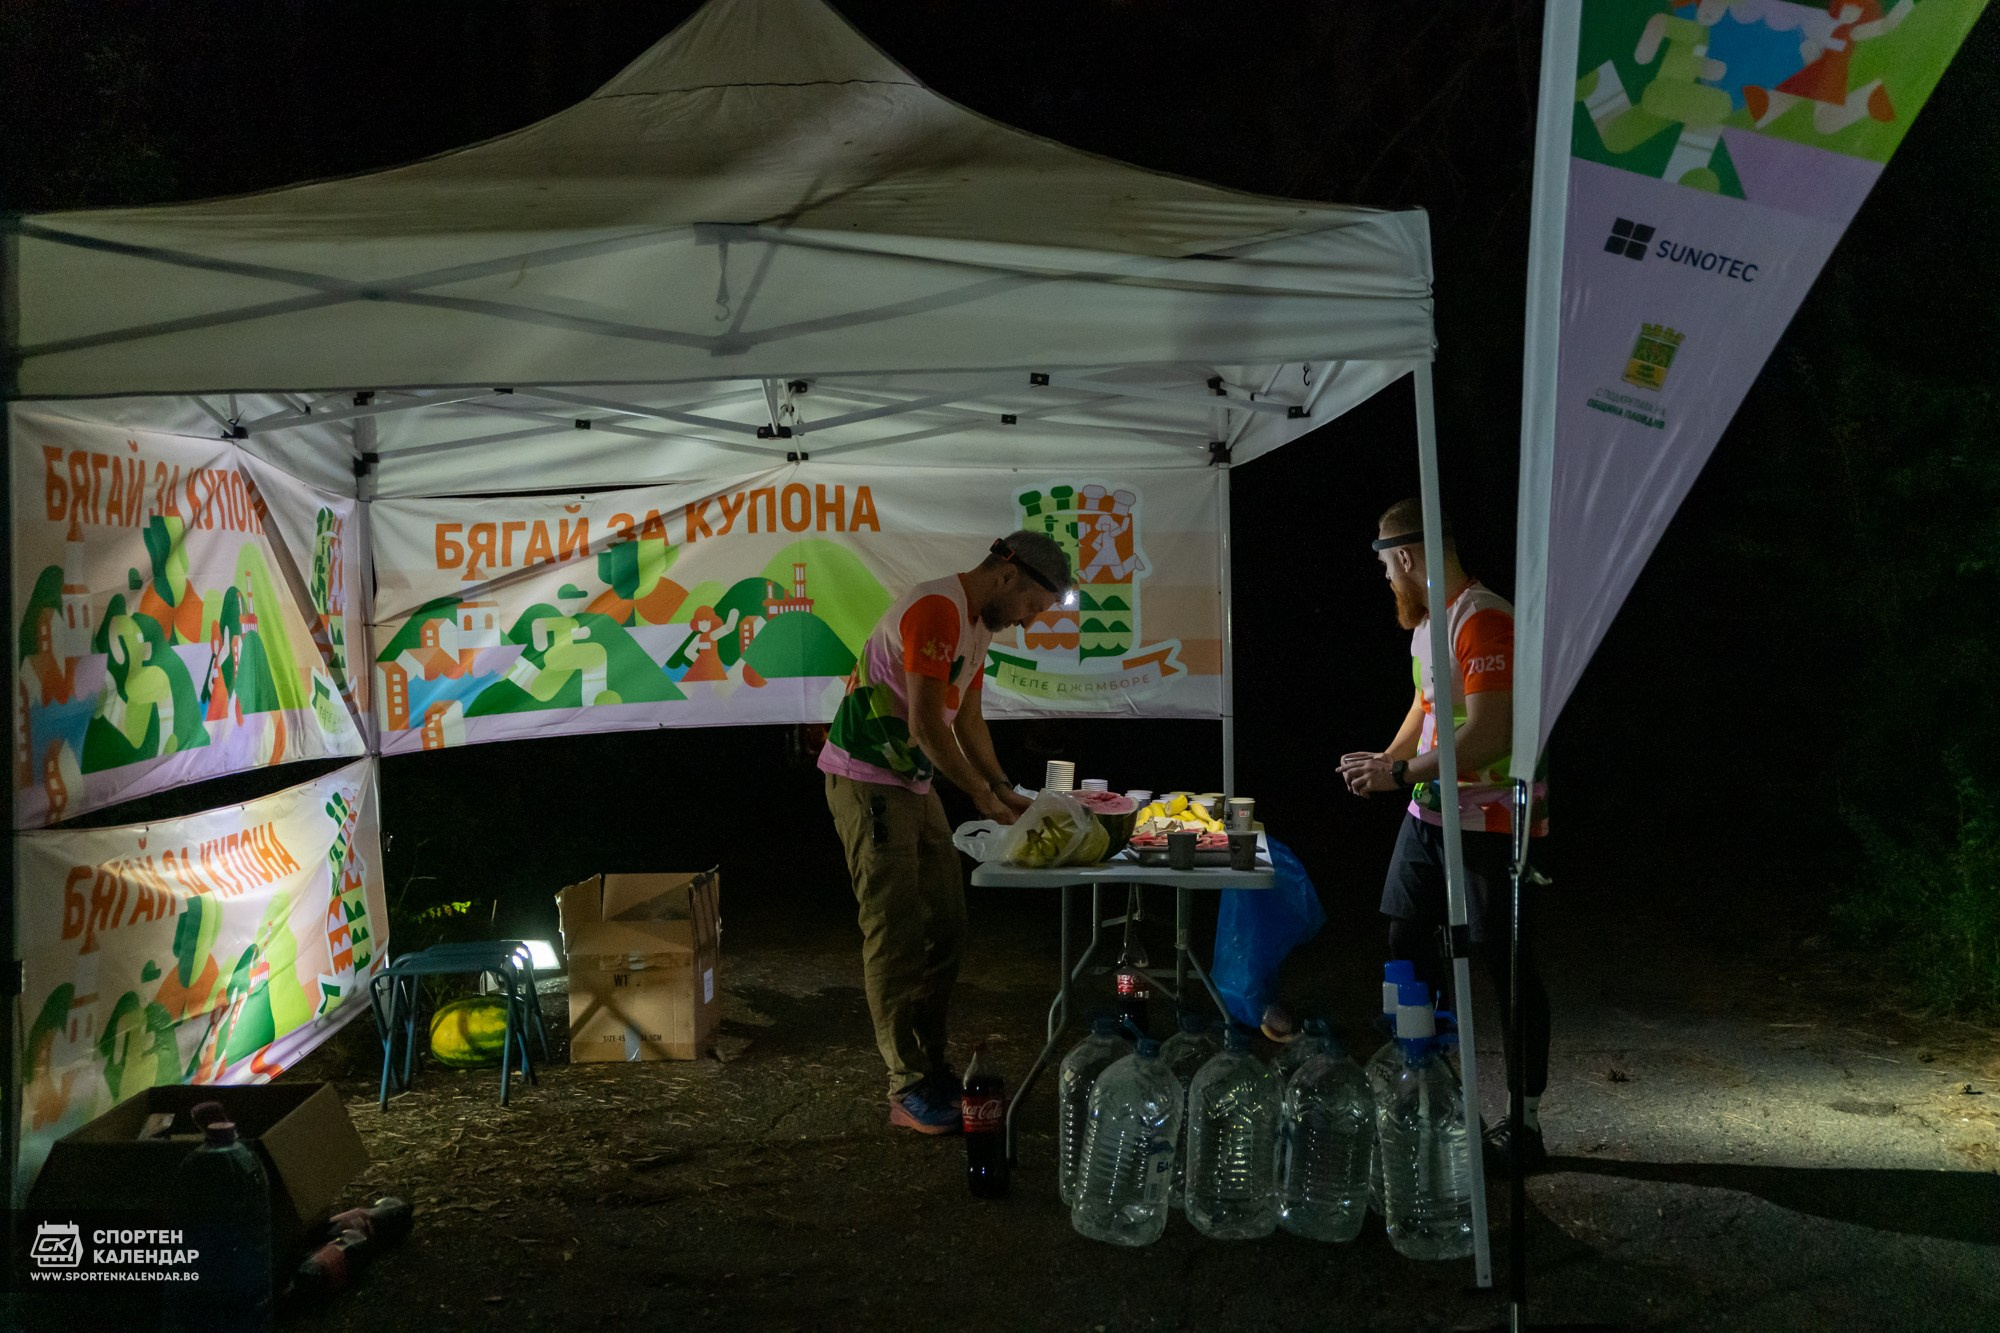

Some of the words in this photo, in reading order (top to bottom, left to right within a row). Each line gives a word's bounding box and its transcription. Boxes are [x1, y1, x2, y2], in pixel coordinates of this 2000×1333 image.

[1656, 240, 1758, 283] SUNOTEC
[43, 440, 145, 528] БЯГАЙ
[435, 504, 589, 570] БЯГАЙ
[606, 508, 670, 548] ЗА
[685, 482, 881, 544] КУПОНА
[1010, 674, 1049, 691] ТЕПЕ
[1056, 674, 1150, 694] ДЖАМБОРЕ
[1467, 654, 1506, 676] 2025
[61, 837, 176, 941] БЯГАЙ
[200, 821, 301, 899] КУПОНА
